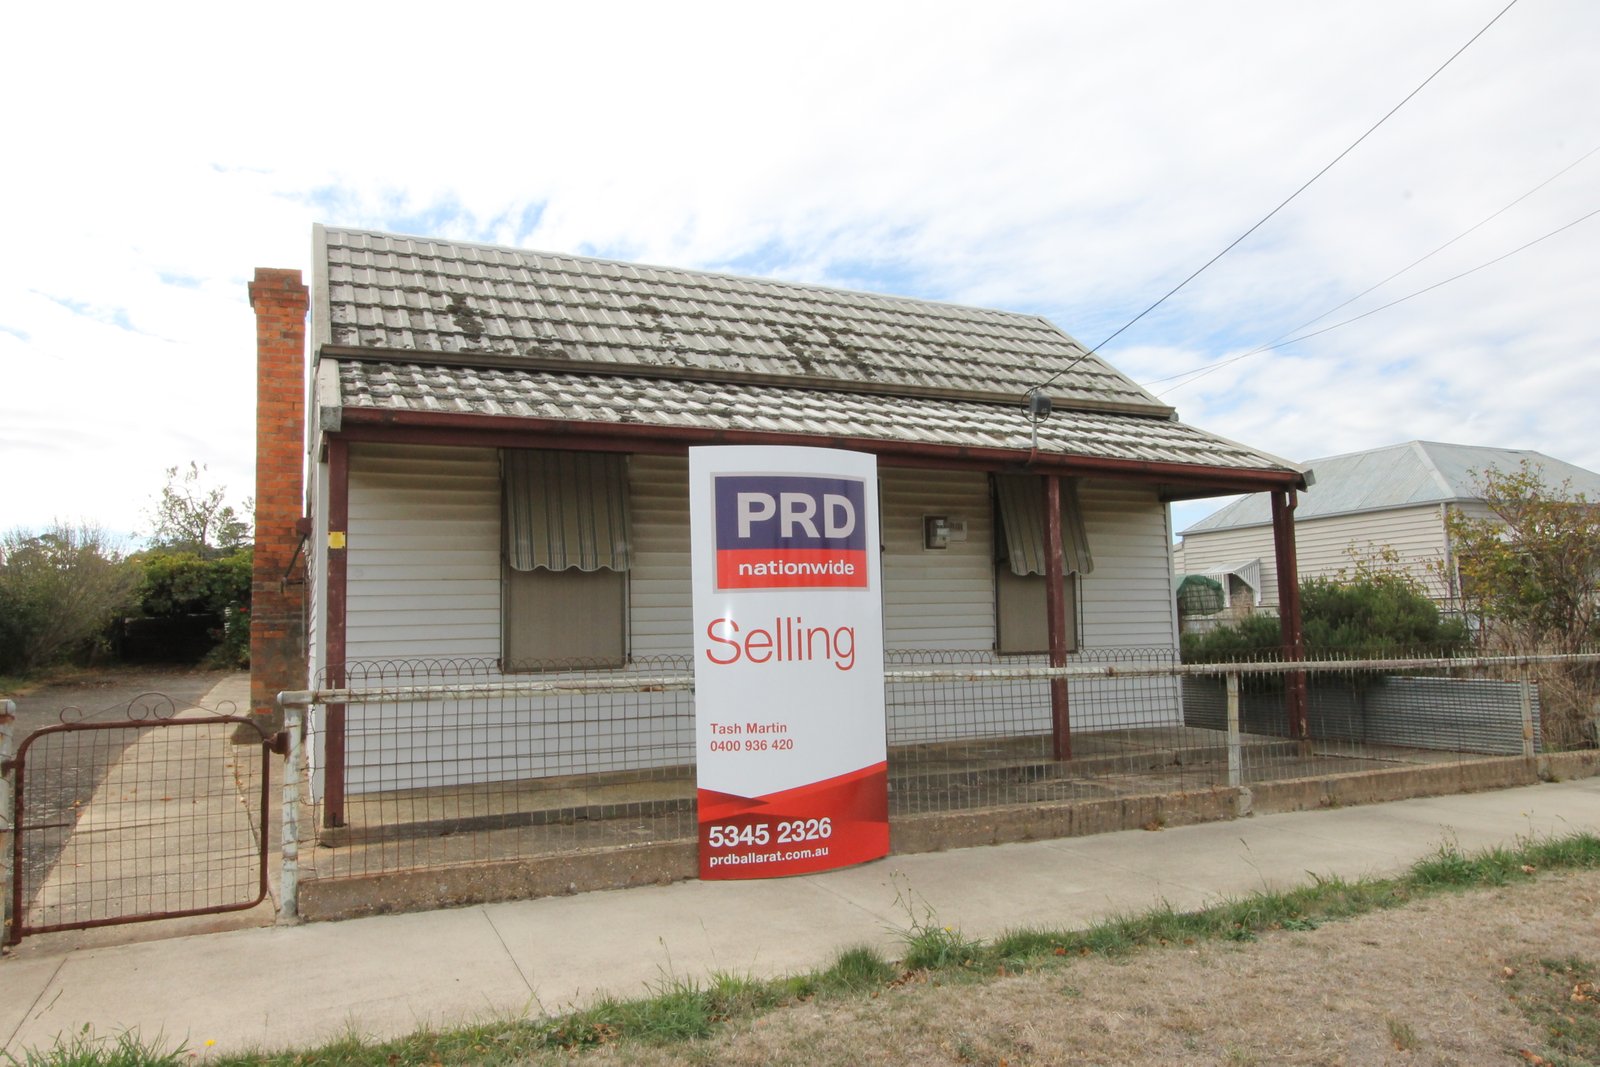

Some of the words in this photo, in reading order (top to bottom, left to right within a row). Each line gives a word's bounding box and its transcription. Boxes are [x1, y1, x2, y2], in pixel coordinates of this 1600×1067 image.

[737, 492, 856, 538] PRD
[738, 559, 855, 576] nationwide
[705, 616, 856, 671] Selling
[710, 723, 742, 735] Tash
[746, 722, 788, 735] Martin
[710, 740, 741, 752] 0400
[745, 739, 768, 752] 936
[771, 739, 794, 751] 420
[708, 823, 770, 848] 5345
[777, 817, 832, 844] 2326
[709, 847, 829, 868] prdballarat.com.au
